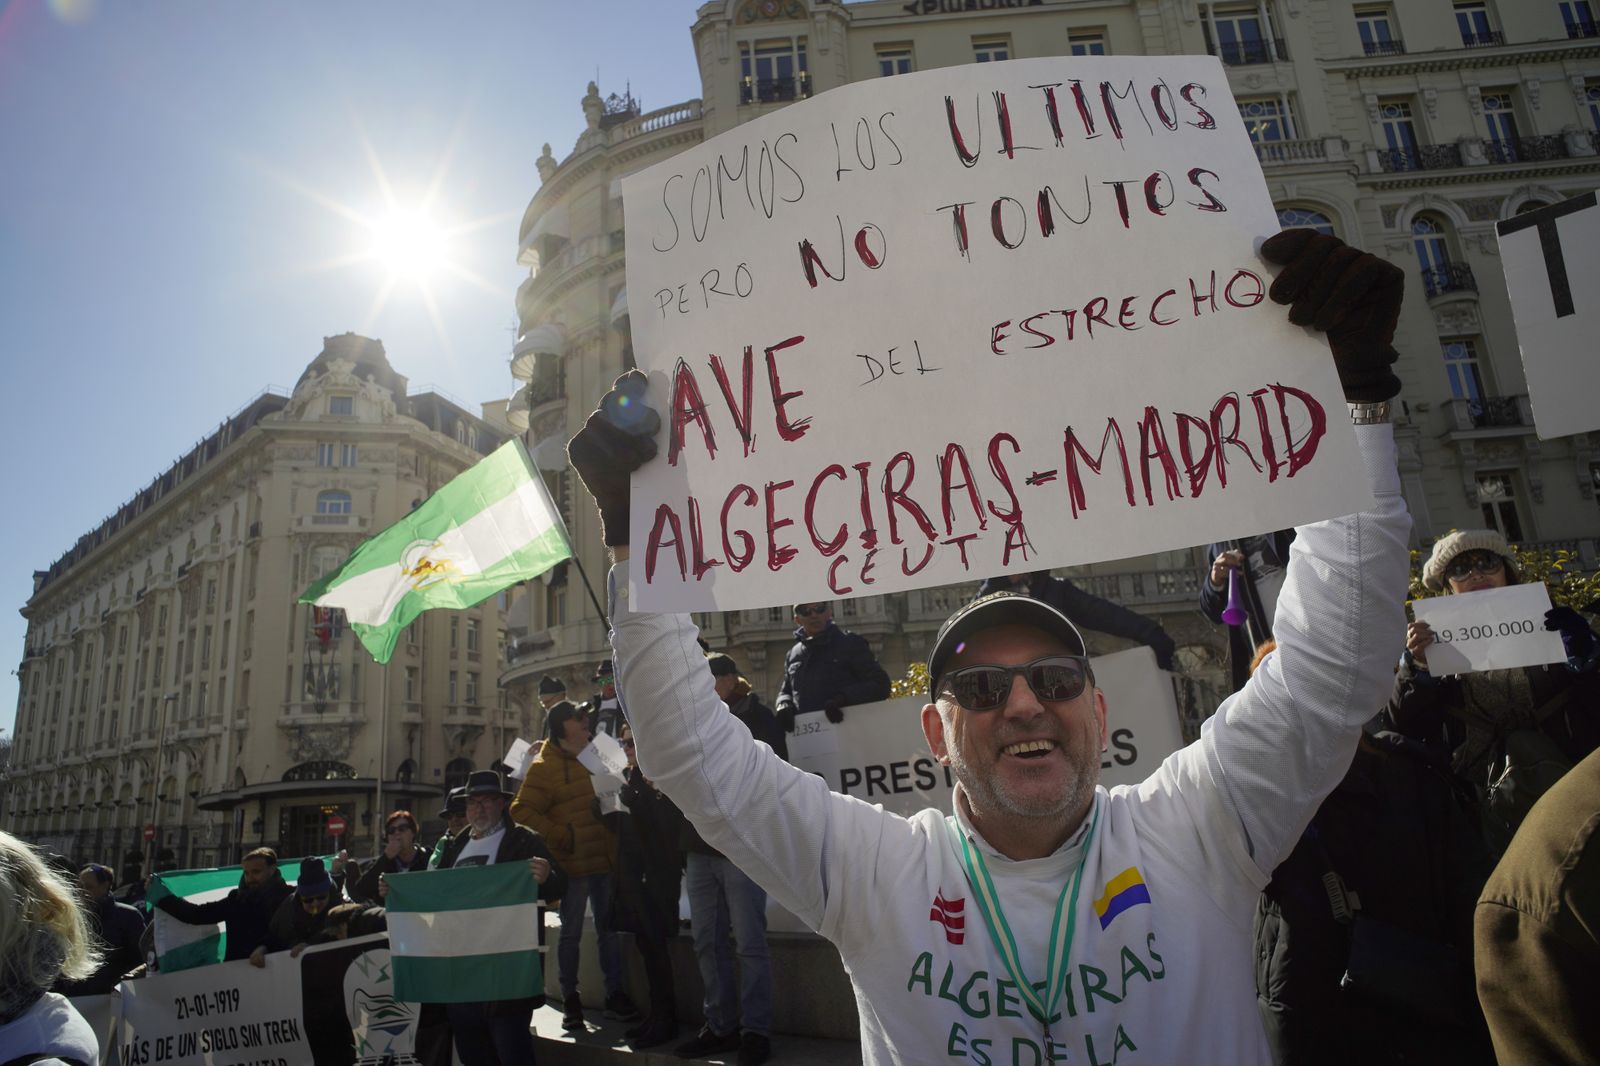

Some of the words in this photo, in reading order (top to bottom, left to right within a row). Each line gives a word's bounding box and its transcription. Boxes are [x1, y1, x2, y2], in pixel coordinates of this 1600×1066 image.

[652, 133, 804, 252] SOMOS
[831, 112, 902, 181] LOS
[945, 77, 1217, 168] ULTIMOS
[655, 263, 753, 318] PERO
[799, 215, 887, 288] NO
[936, 168, 1227, 263] TONTOS
[668, 336, 813, 467] AVE
[856, 340, 943, 386] DEL
[991, 268, 1265, 355] ESTRECHO
[827, 522, 1038, 595] CEUTA
[1433, 619, 1534, 644] 19.300.000
[175, 988, 240, 1020] 21-01-1919
[155, 1036, 174, 1061] DE
[178, 1032, 197, 1057] UN
[202, 1026, 239, 1053] SIGLO
[240, 1023, 263, 1048] SIN
[264, 1018, 301, 1045] TREN
[948, 1022, 993, 1066] ES
[1084, 1024, 1138, 1066] LA
